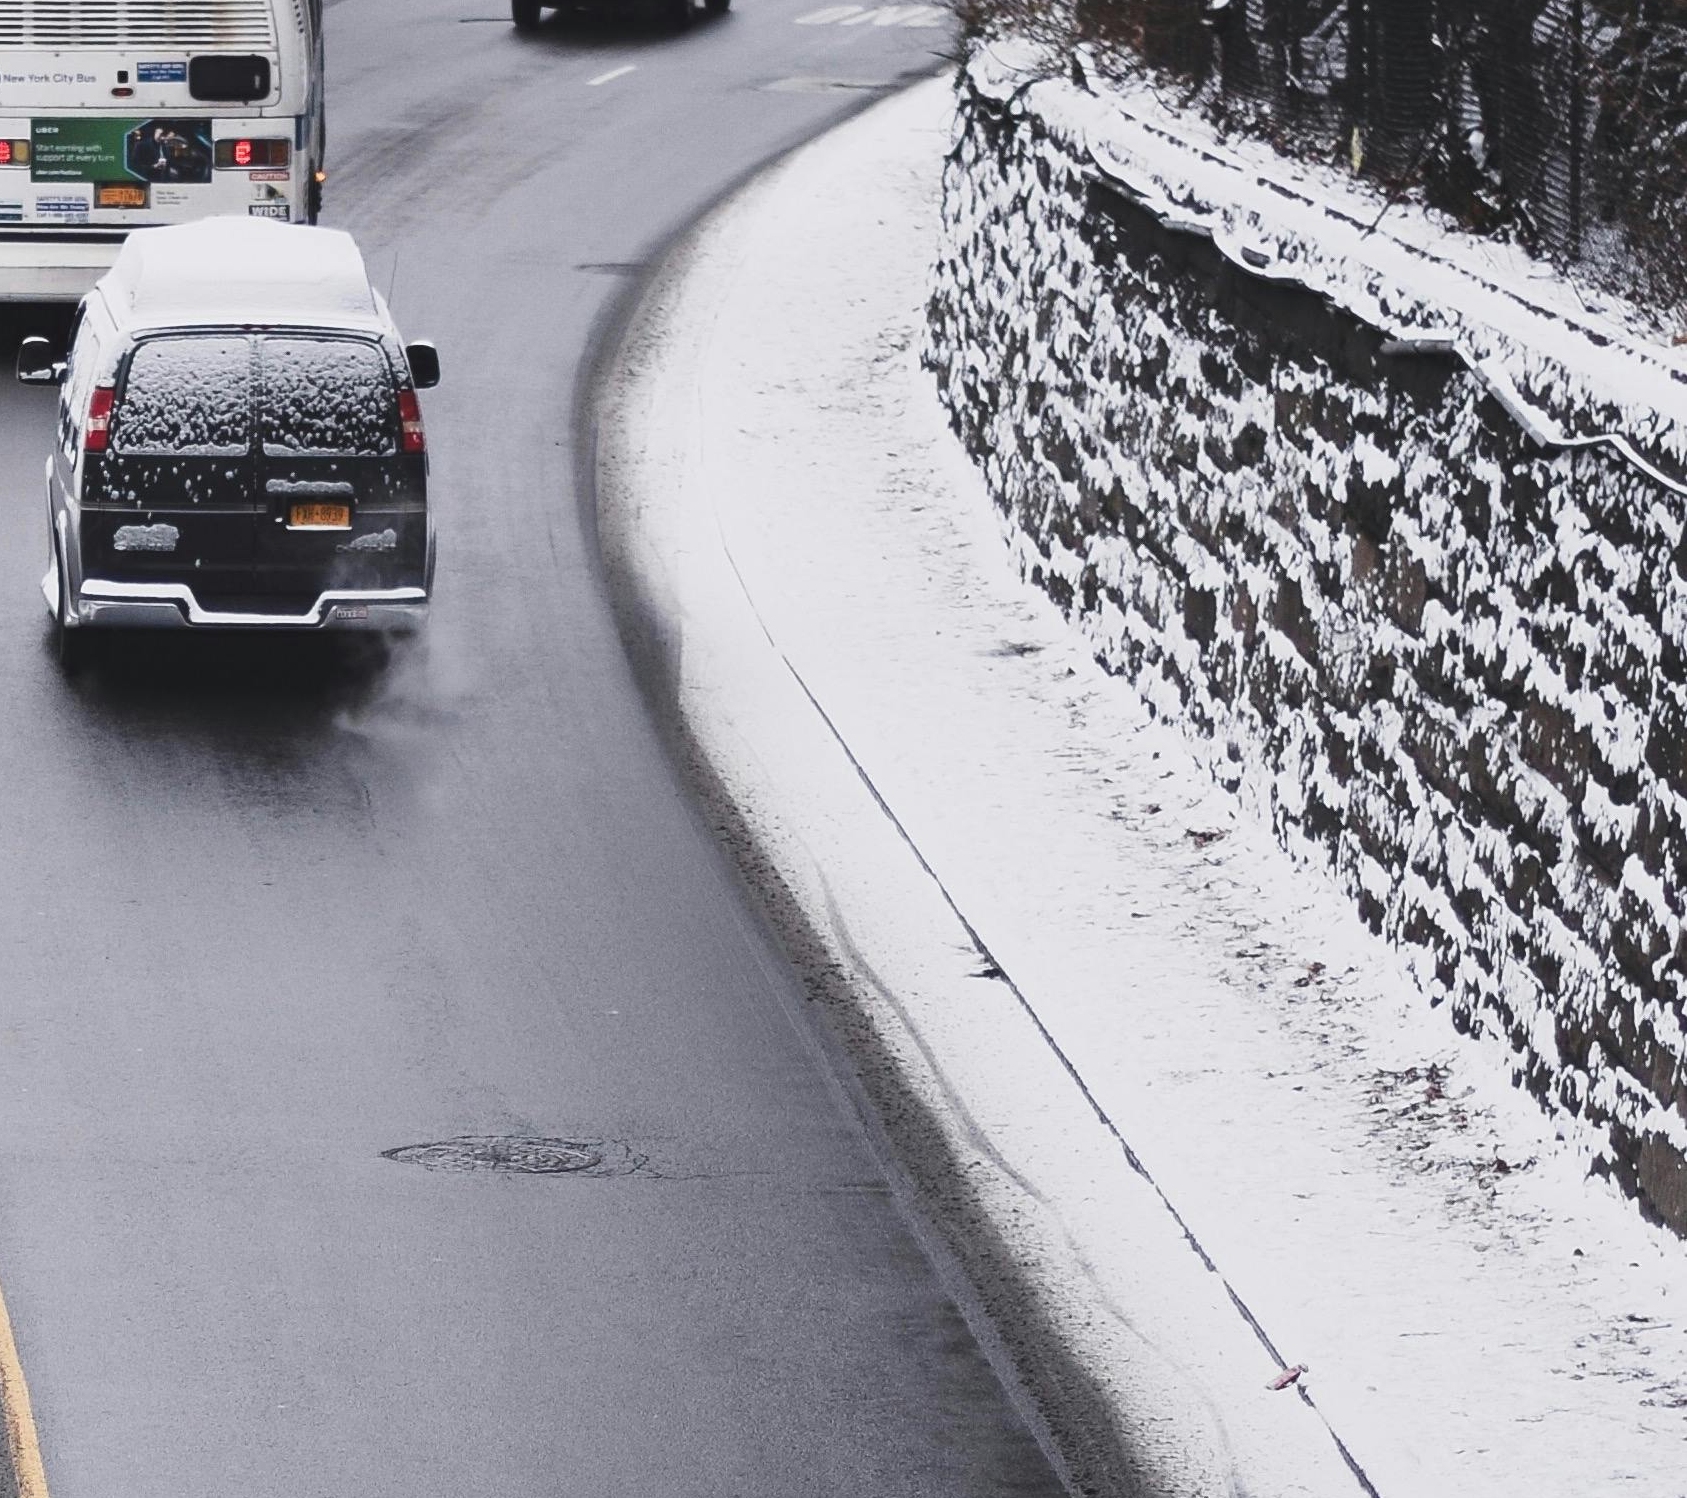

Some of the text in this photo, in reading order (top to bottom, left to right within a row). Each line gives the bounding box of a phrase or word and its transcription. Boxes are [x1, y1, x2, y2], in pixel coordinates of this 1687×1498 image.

[3, 73, 25, 82] New
[28, 73, 50, 83] York
[53, 73, 74, 85] City
[76, 73, 97, 83] Bus
[35, 143, 54, 152] Start
[251, 206, 288, 217] WIDE
